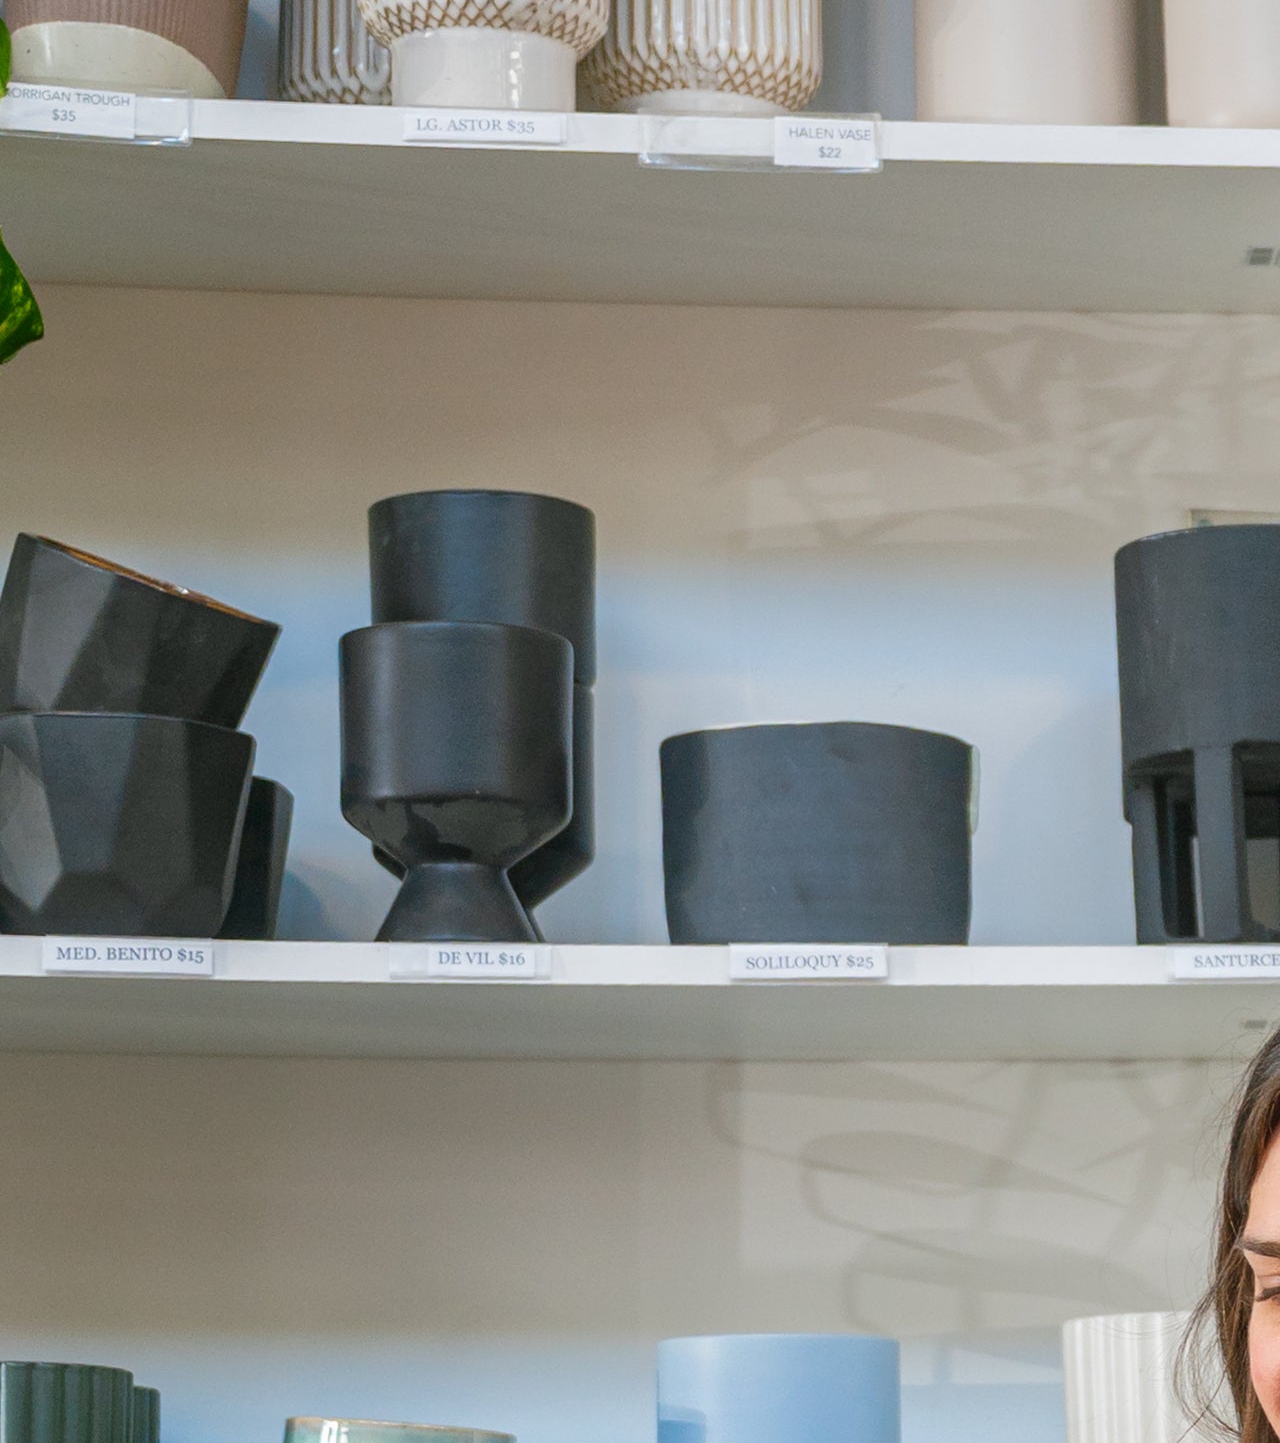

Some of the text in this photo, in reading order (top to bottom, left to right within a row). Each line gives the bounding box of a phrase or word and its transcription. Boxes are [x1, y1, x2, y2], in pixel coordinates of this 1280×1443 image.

[75, 92, 130, 107] TROUGH
[52, 108, 76, 122] $35
[416, 118, 535, 134] LG. ASTOR $35
[788, 127, 872, 141] HALEN VASE
[819, 146, 841, 159] $22
[56, 946, 204, 964] MED. BENITO $15
[438, 951, 525, 966] DE VIL $16
[746, 955, 874, 970] SOLILOQUY $25
